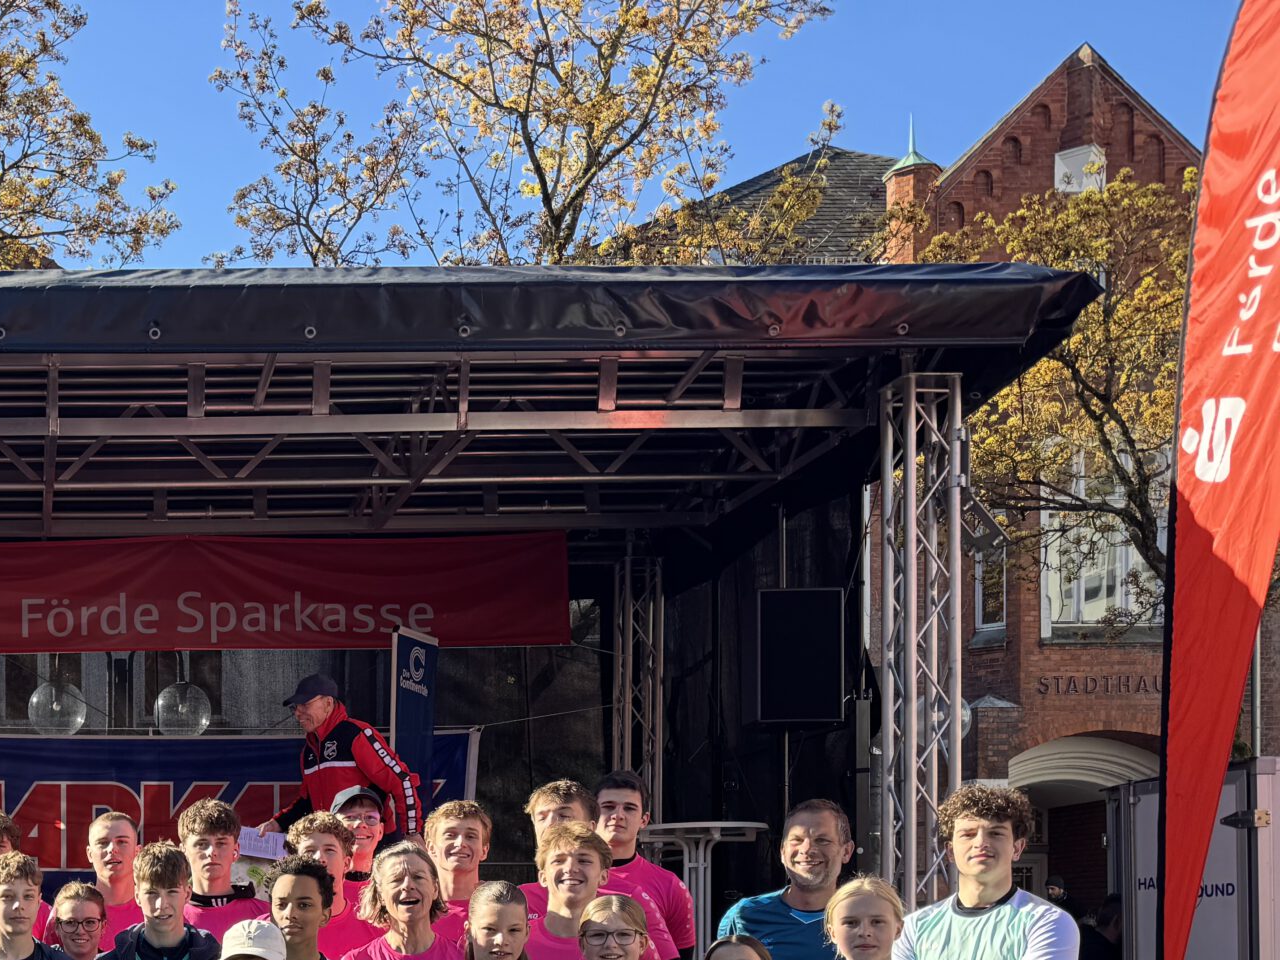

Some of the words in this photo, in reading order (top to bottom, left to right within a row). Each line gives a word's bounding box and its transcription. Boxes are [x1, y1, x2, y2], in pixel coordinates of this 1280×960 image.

[1222, 169, 1280, 357] Förde
[21, 597, 160, 638] Förde
[176, 591, 435, 642] Sparkasse
